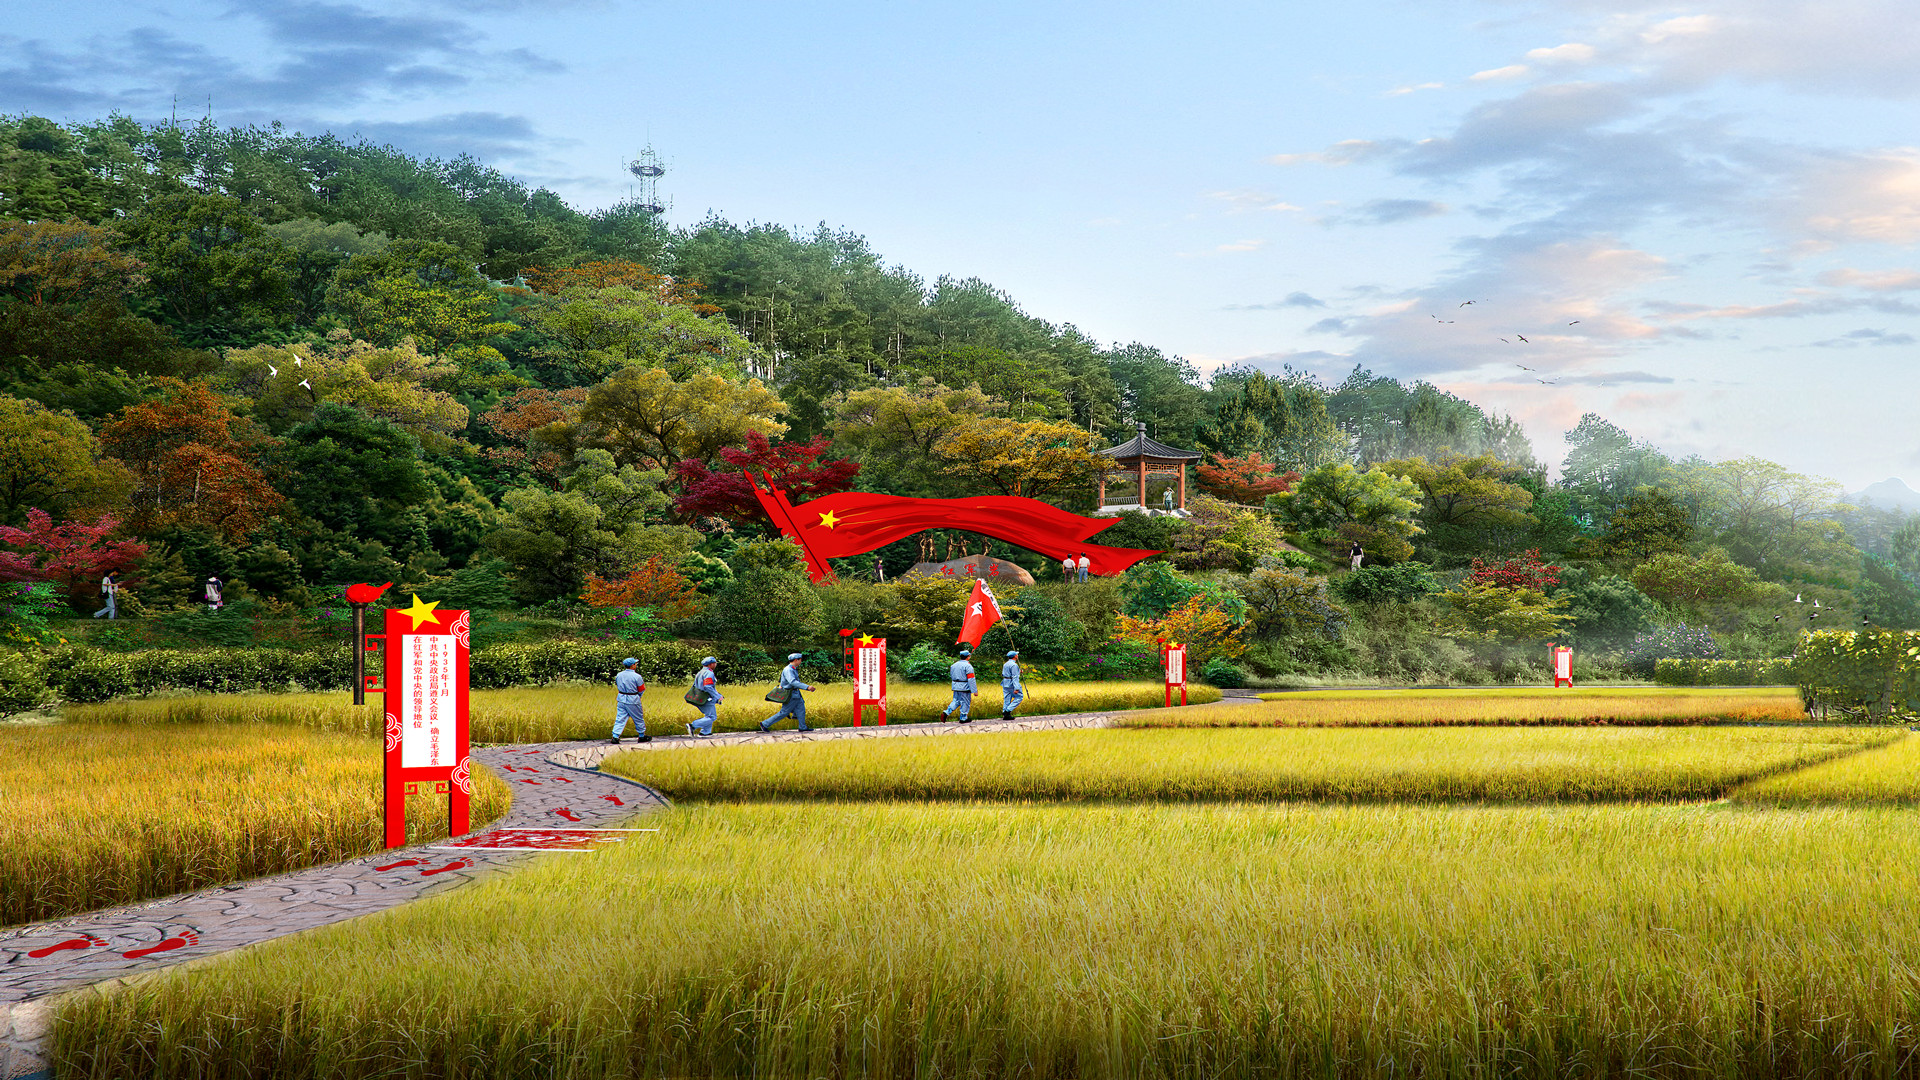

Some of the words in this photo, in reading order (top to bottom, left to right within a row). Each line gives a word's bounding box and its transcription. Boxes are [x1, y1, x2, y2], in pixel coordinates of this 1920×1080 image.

[940, 563, 1000, 577] 红军岩
[413, 636, 423, 728] 在红军和党中央的领导地位
[441, 643, 450, 697] 1935年1月
